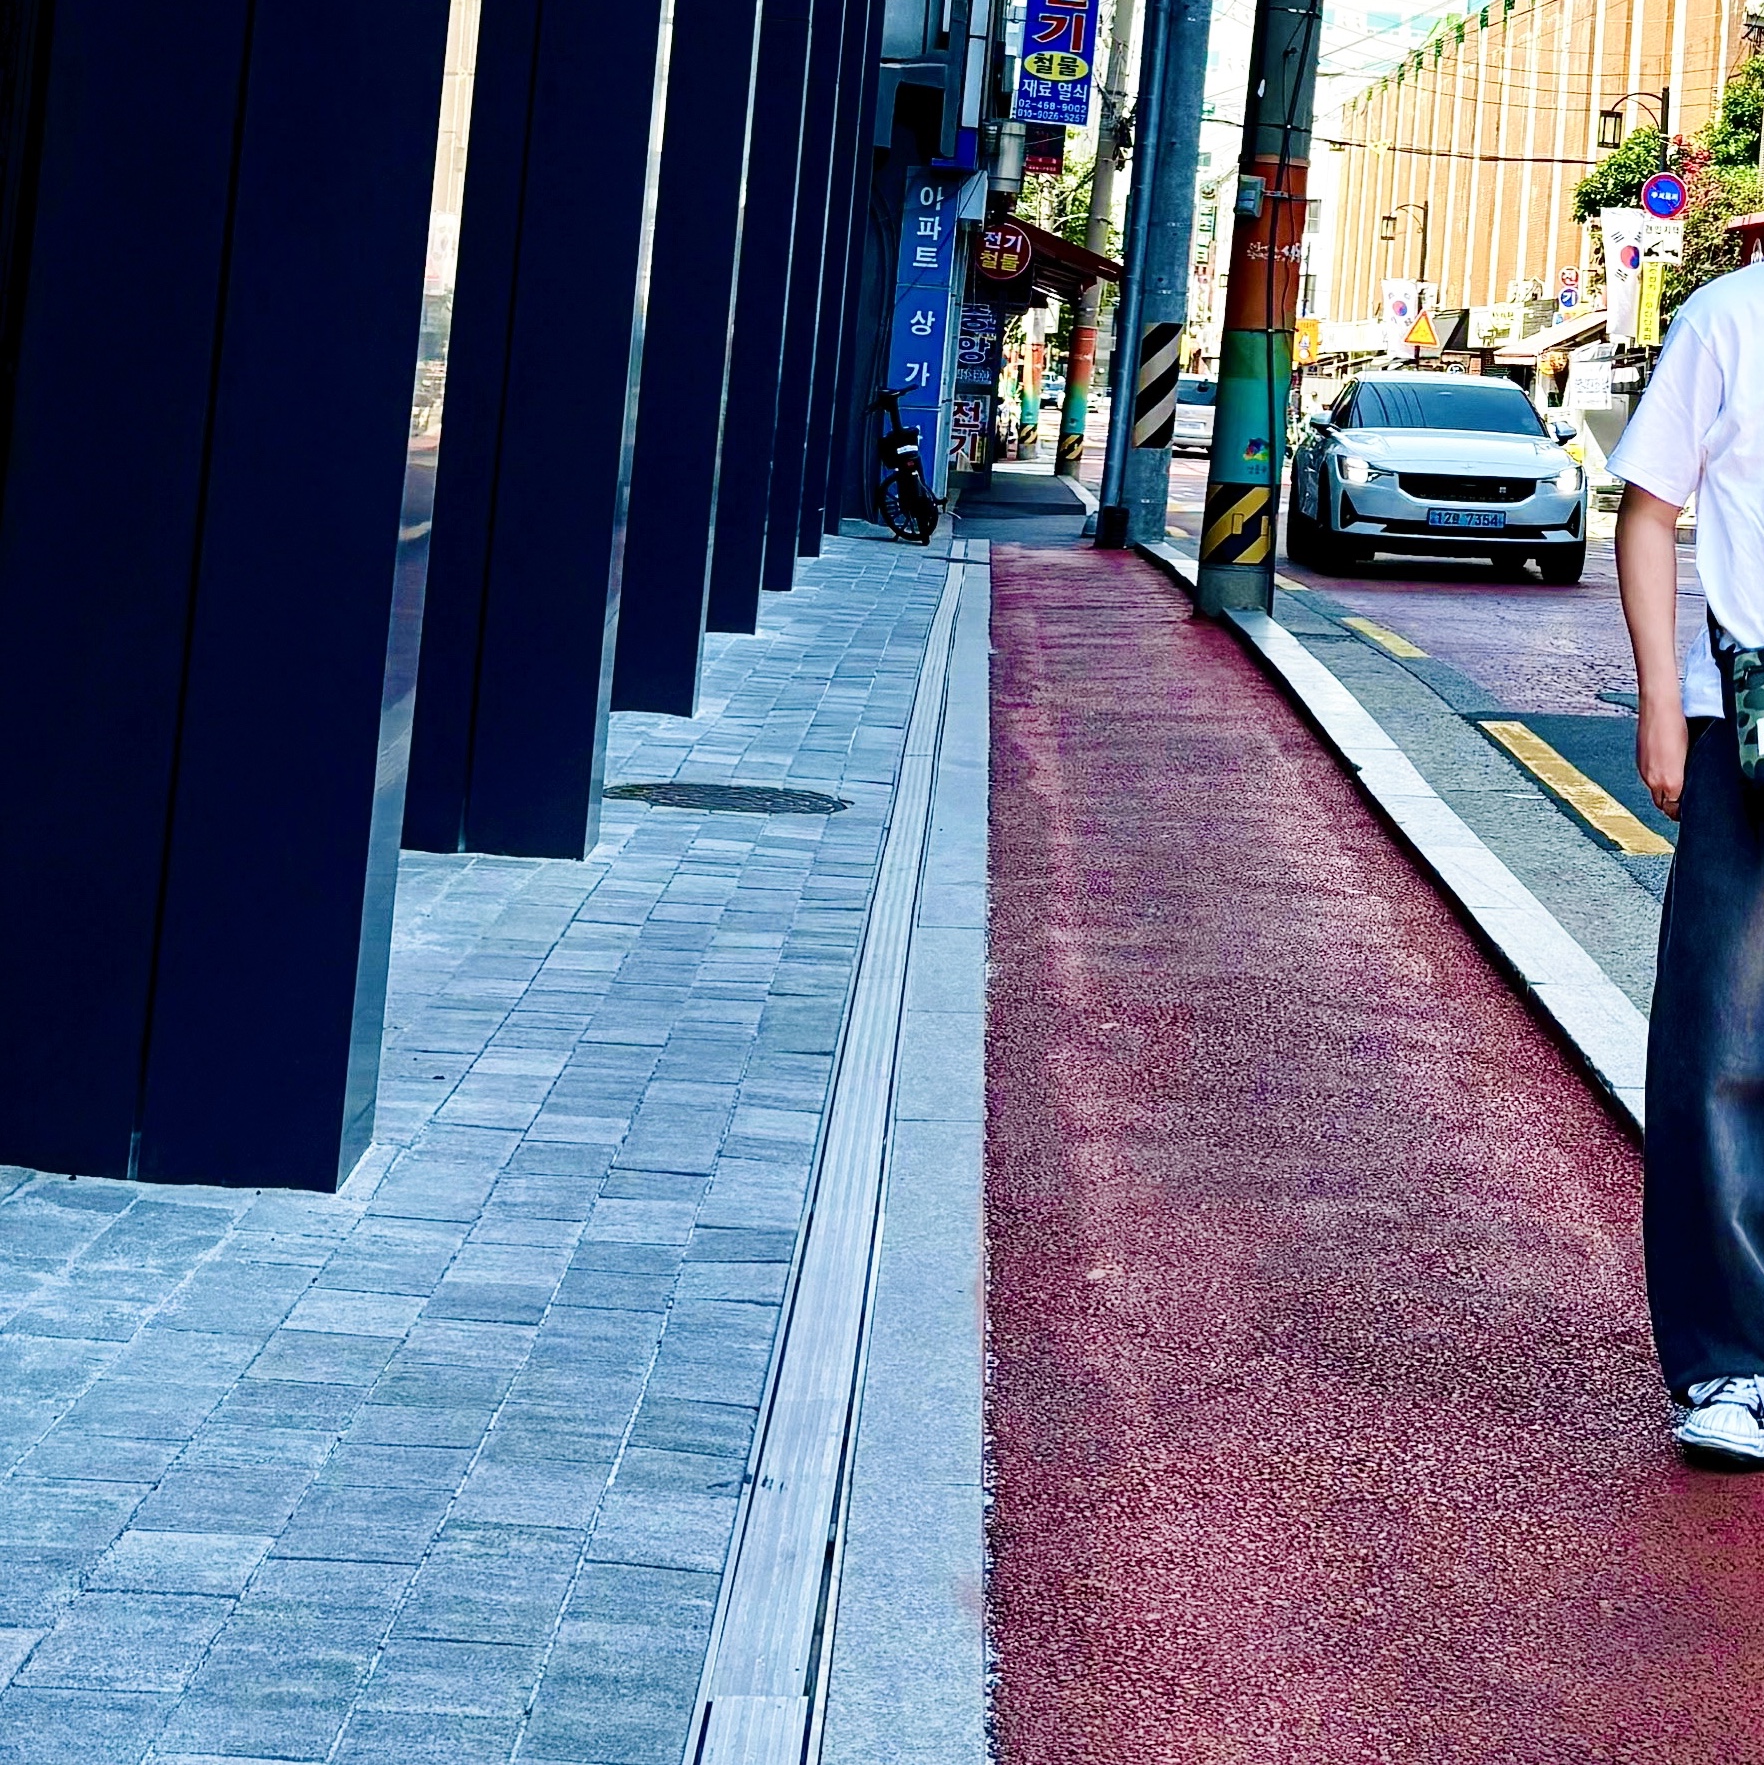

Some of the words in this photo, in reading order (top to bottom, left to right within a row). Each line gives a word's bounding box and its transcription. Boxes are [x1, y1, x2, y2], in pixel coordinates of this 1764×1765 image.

[1033, 53, 1080, 77] 철물
[1022, 79, 1052, 99] 재료
[1057, 82, 1088, 103] 열쇠
[911, 186, 945, 270] 아파트
[984, 232, 1023, 253] 전기
